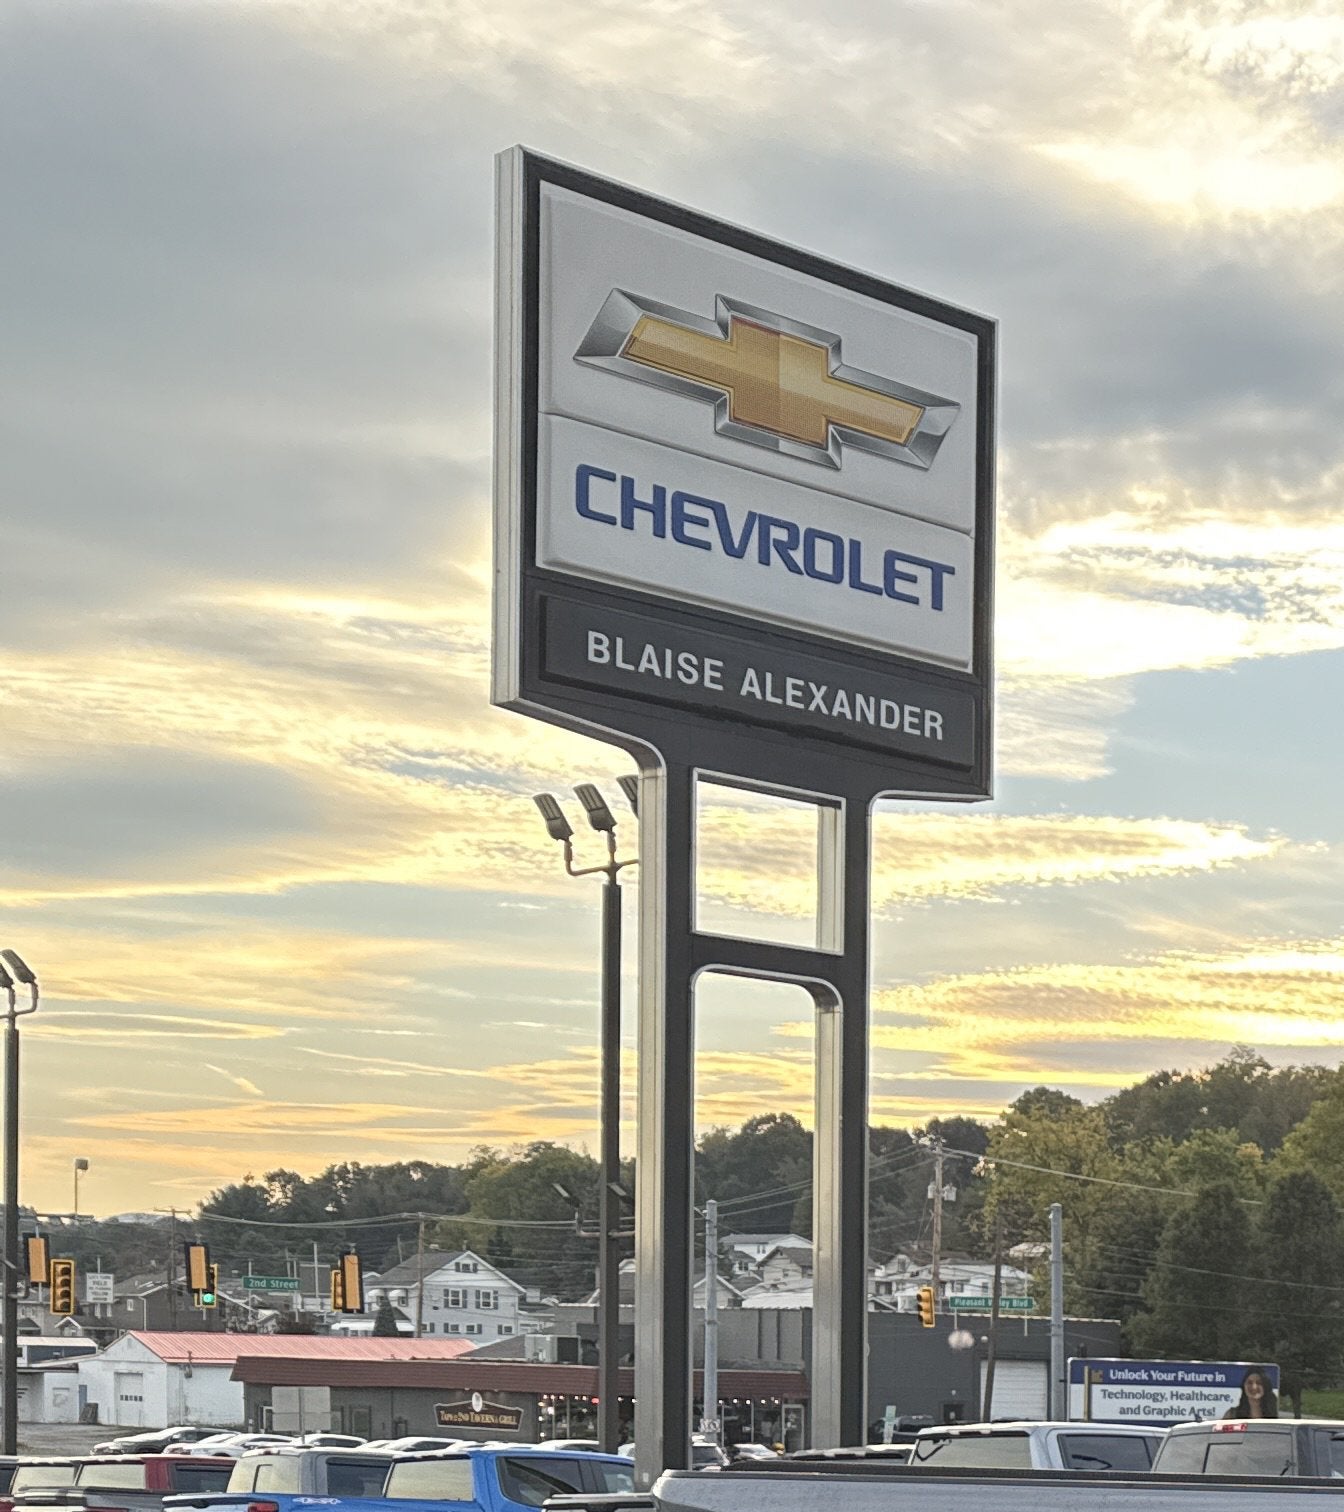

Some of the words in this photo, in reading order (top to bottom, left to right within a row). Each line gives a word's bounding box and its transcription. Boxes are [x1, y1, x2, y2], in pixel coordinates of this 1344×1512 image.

[575, 463, 956, 611] CHEVROLET
[587, 630, 724, 692] BLAISE
[740, 666, 945, 741] ALEXANDER
[248, 1279, 267, 1288] 2nd
[270, 1279, 299, 1289] Street
[954, 1298, 986, 1307] Pleasant
[1012, 1299, 1028, 1307] Blvd
[1109, 1368, 1149, 1381] Unlock
[1151, 1370, 1176, 1382] Your
[1177, 1371, 1213, 1382] Future
[1215, 1371, 1226, 1382] in
[1101, 1389, 1168, 1402] Technology,
[1170, 1390, 1234, 1403] Healthcare,
[1119, 1404, 1141, 1416] and
[1143, 1405, 1187, 1418] Graphic
[1188, 1406, 1216, 1417] Arts!
